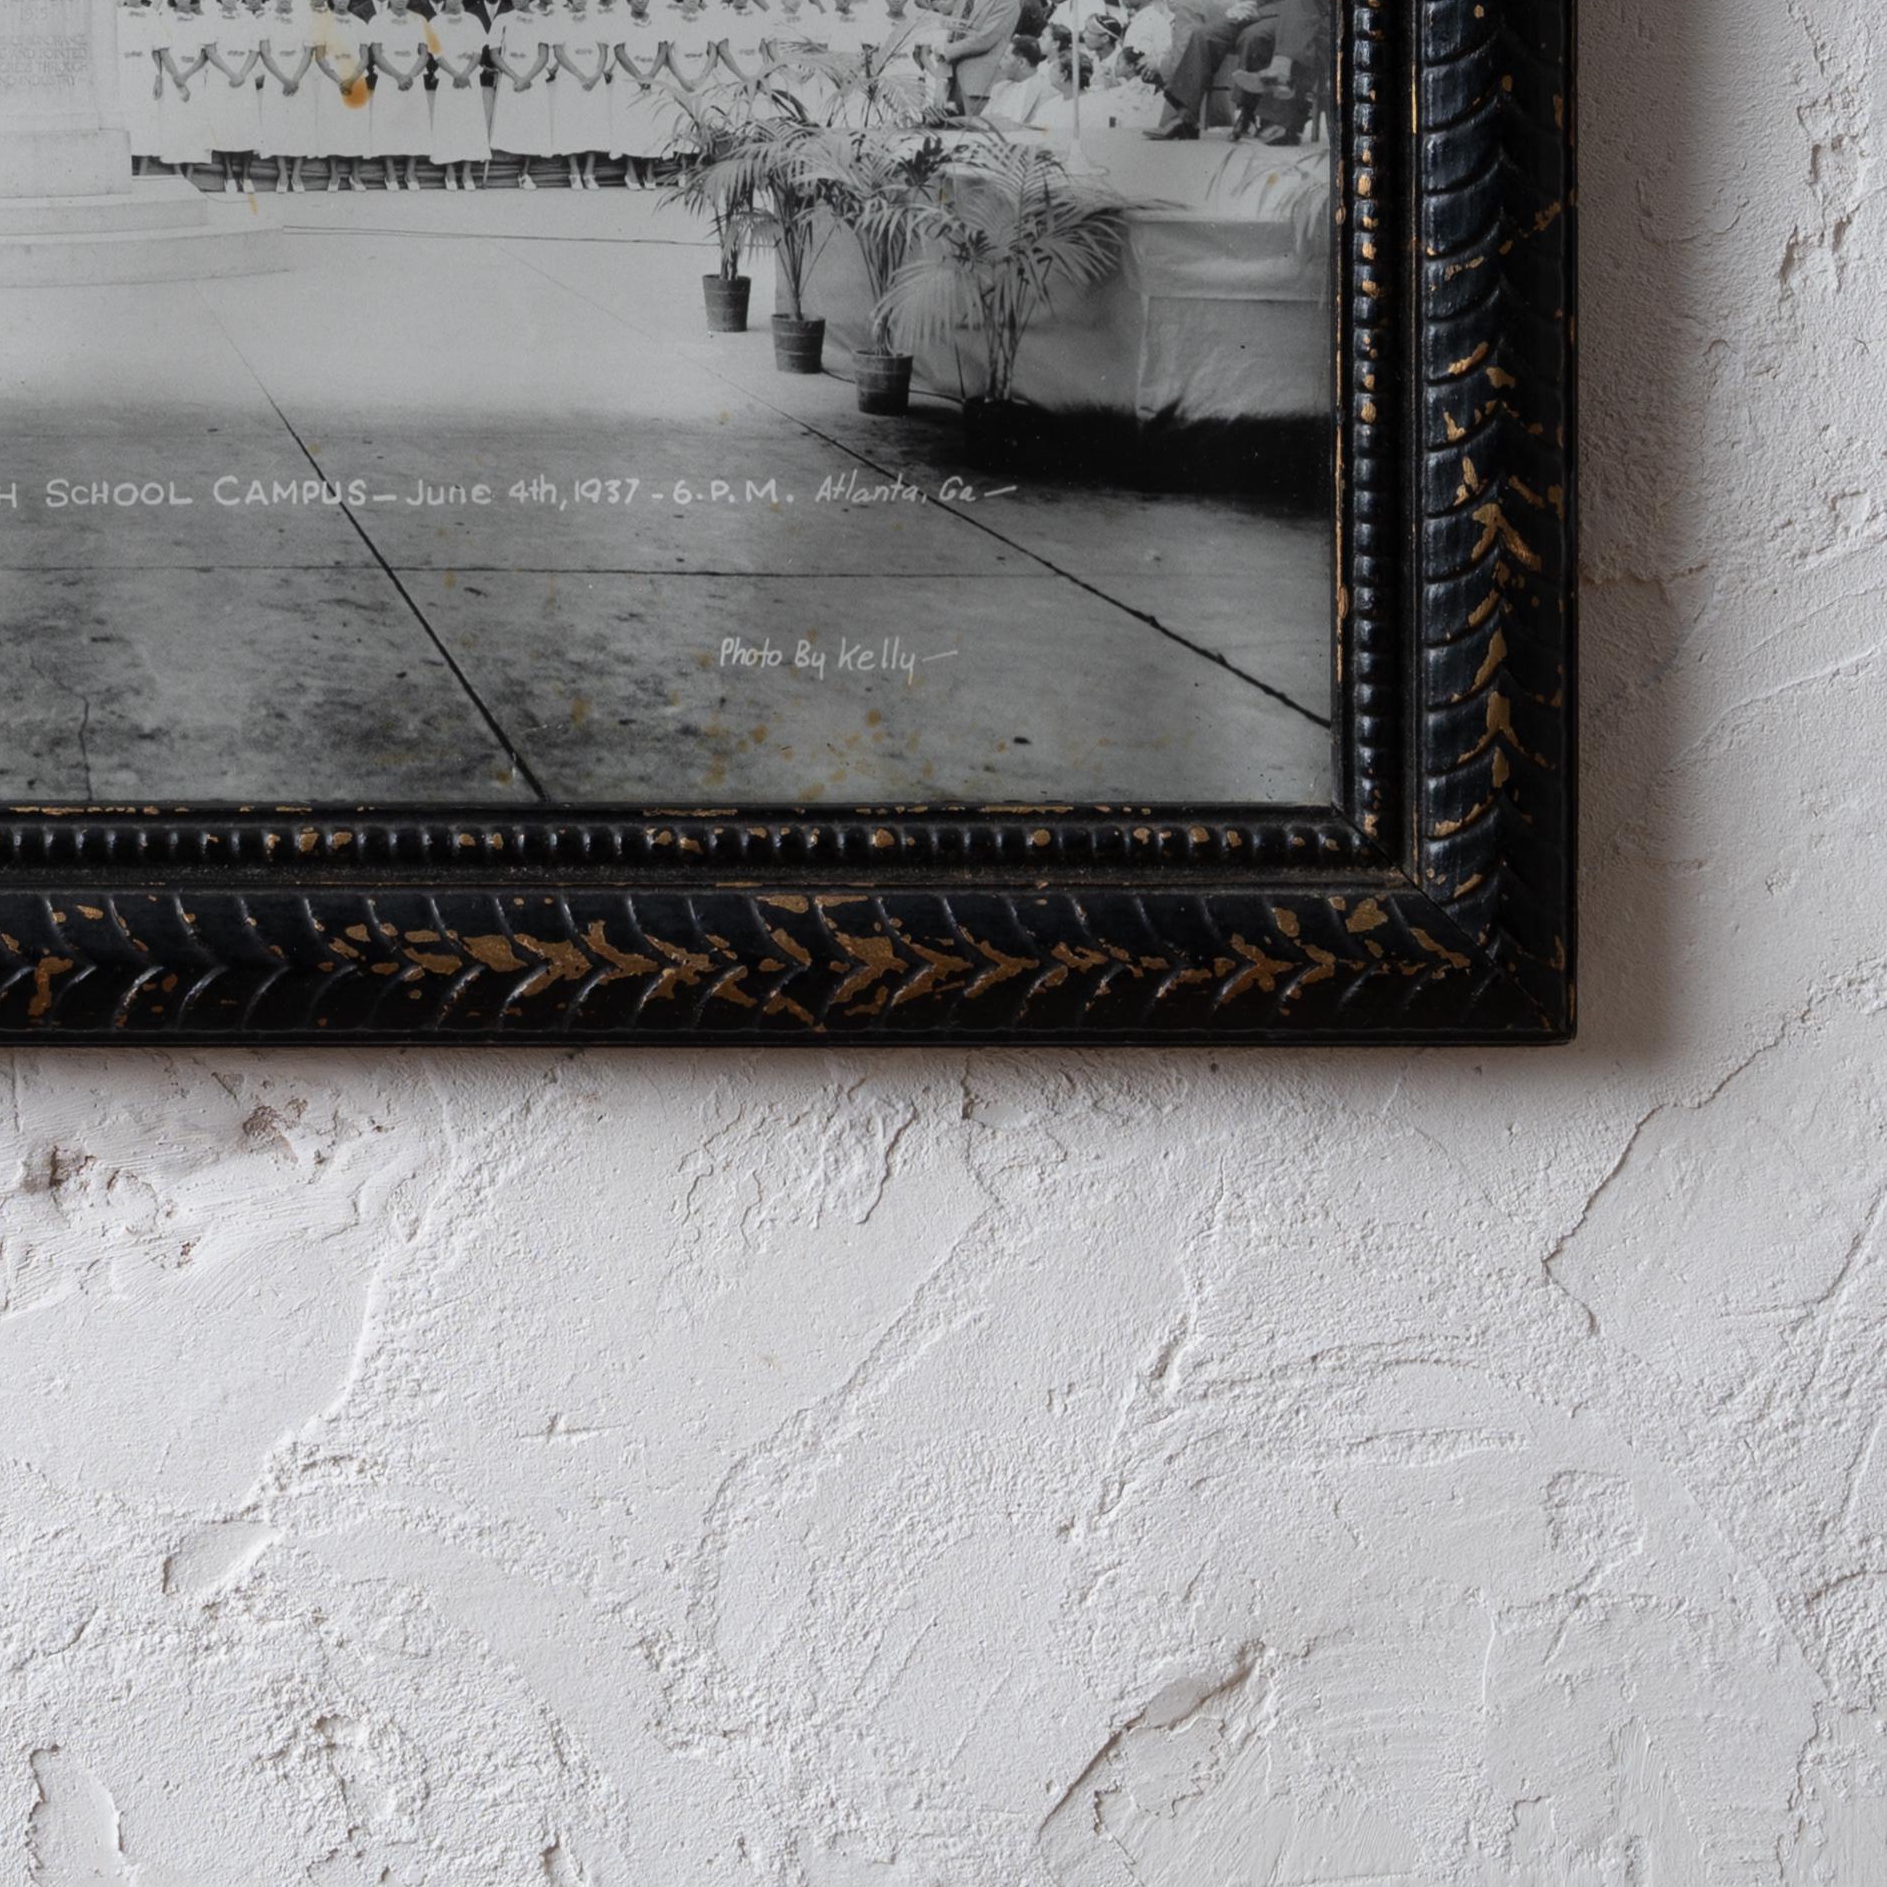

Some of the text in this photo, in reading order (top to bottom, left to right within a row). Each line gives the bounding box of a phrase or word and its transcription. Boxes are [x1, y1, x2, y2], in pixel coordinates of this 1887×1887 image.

[45, 477, 194, 508] SCHOOL
[405, 478, 493, 507] June
[814, 469, 927, 505] Atlanta,
[719, 636, 783, 669] Photo
[794, 639, 826, 680] By
[837, 636, 916, 685] Kelly
